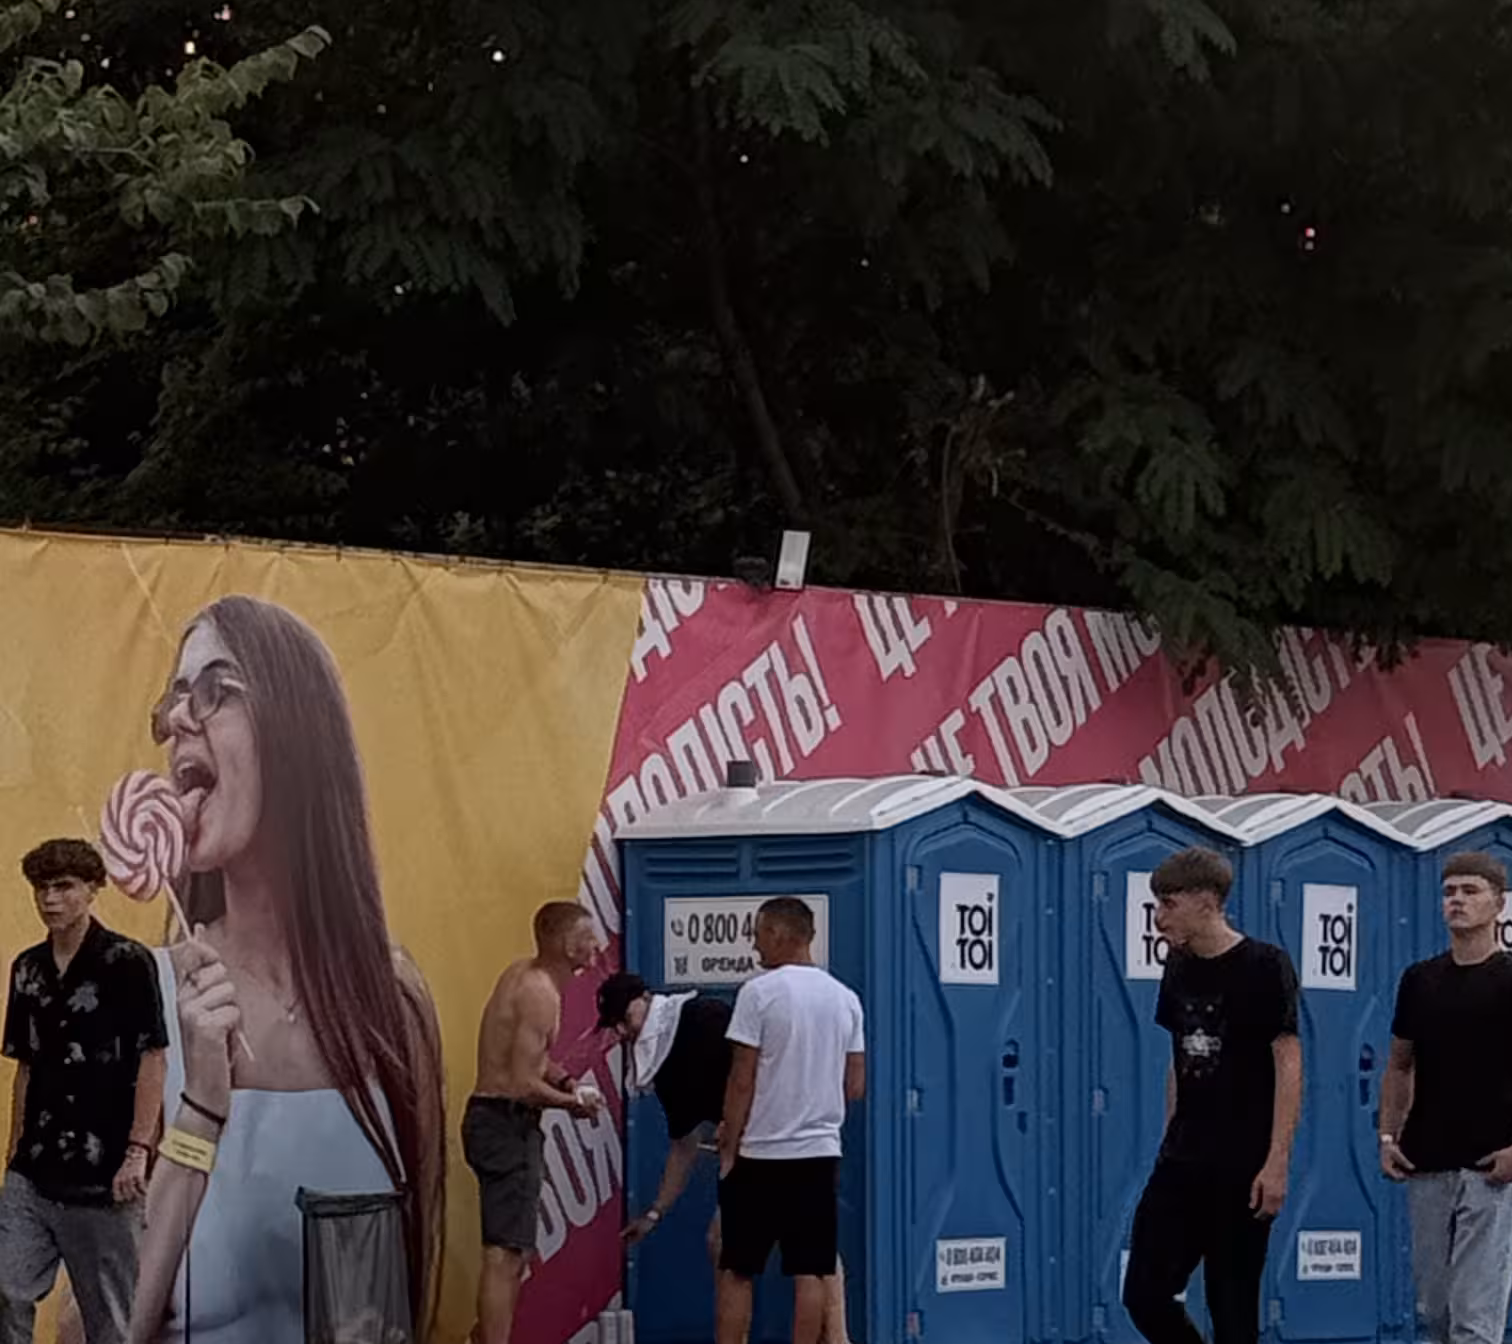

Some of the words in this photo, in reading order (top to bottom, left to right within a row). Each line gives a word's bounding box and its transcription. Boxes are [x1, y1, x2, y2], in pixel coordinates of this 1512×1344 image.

[968, 609, 1101, 787] ТВОЯ
[687, 913, 700, 944] 0
[703, 913, 738, 944] 800
[956, 938, 993, 971] TOI
[1142, 935, 1170, 967] TO
[1318, 945, 1351, 978] TOI
